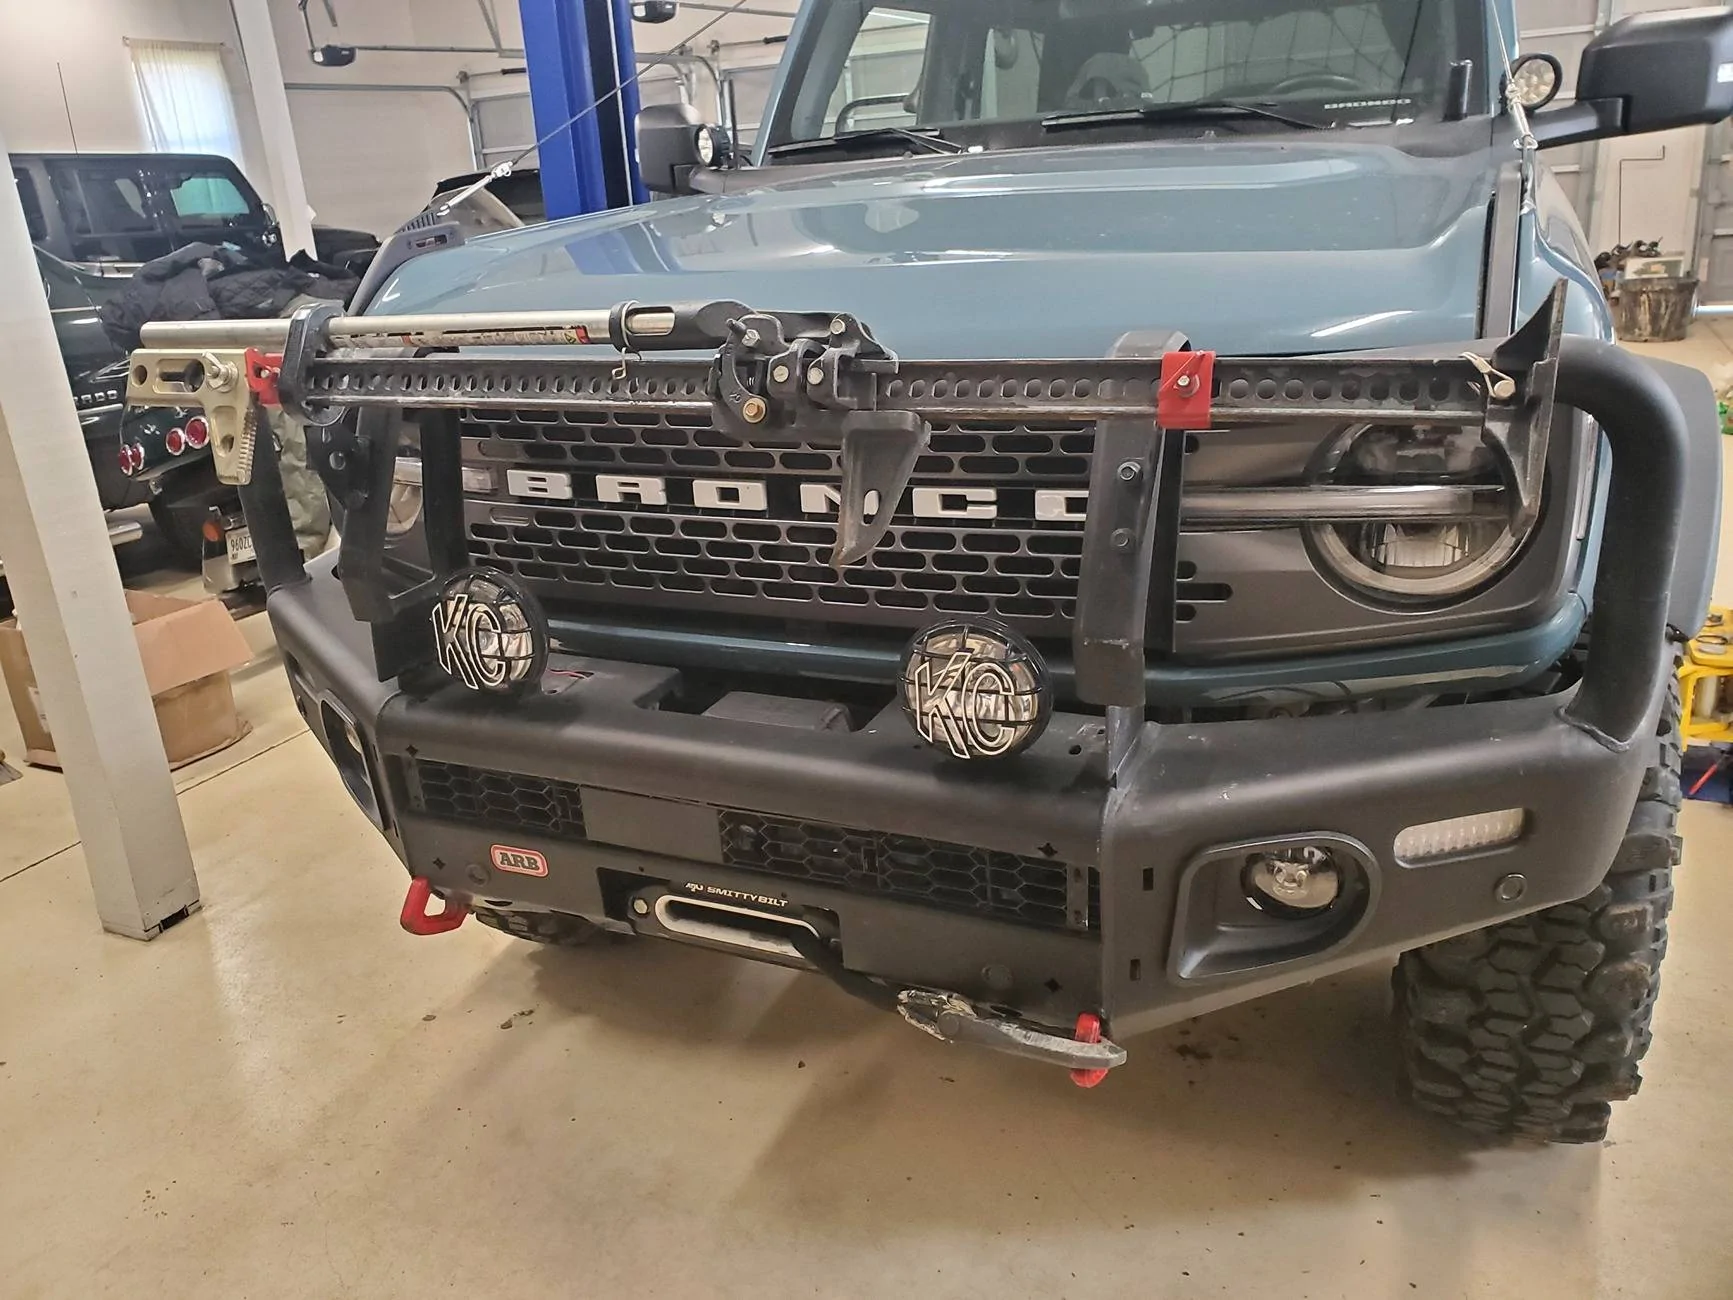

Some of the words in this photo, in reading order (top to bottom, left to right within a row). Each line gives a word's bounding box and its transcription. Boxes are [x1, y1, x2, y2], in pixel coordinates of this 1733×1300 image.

[432, 594, 506, 690] KC
[914, 651, 1015, 760] KC
[499, 852, 540, 871] ARB
[706, 886, 788, 907] SMITTYBILT
